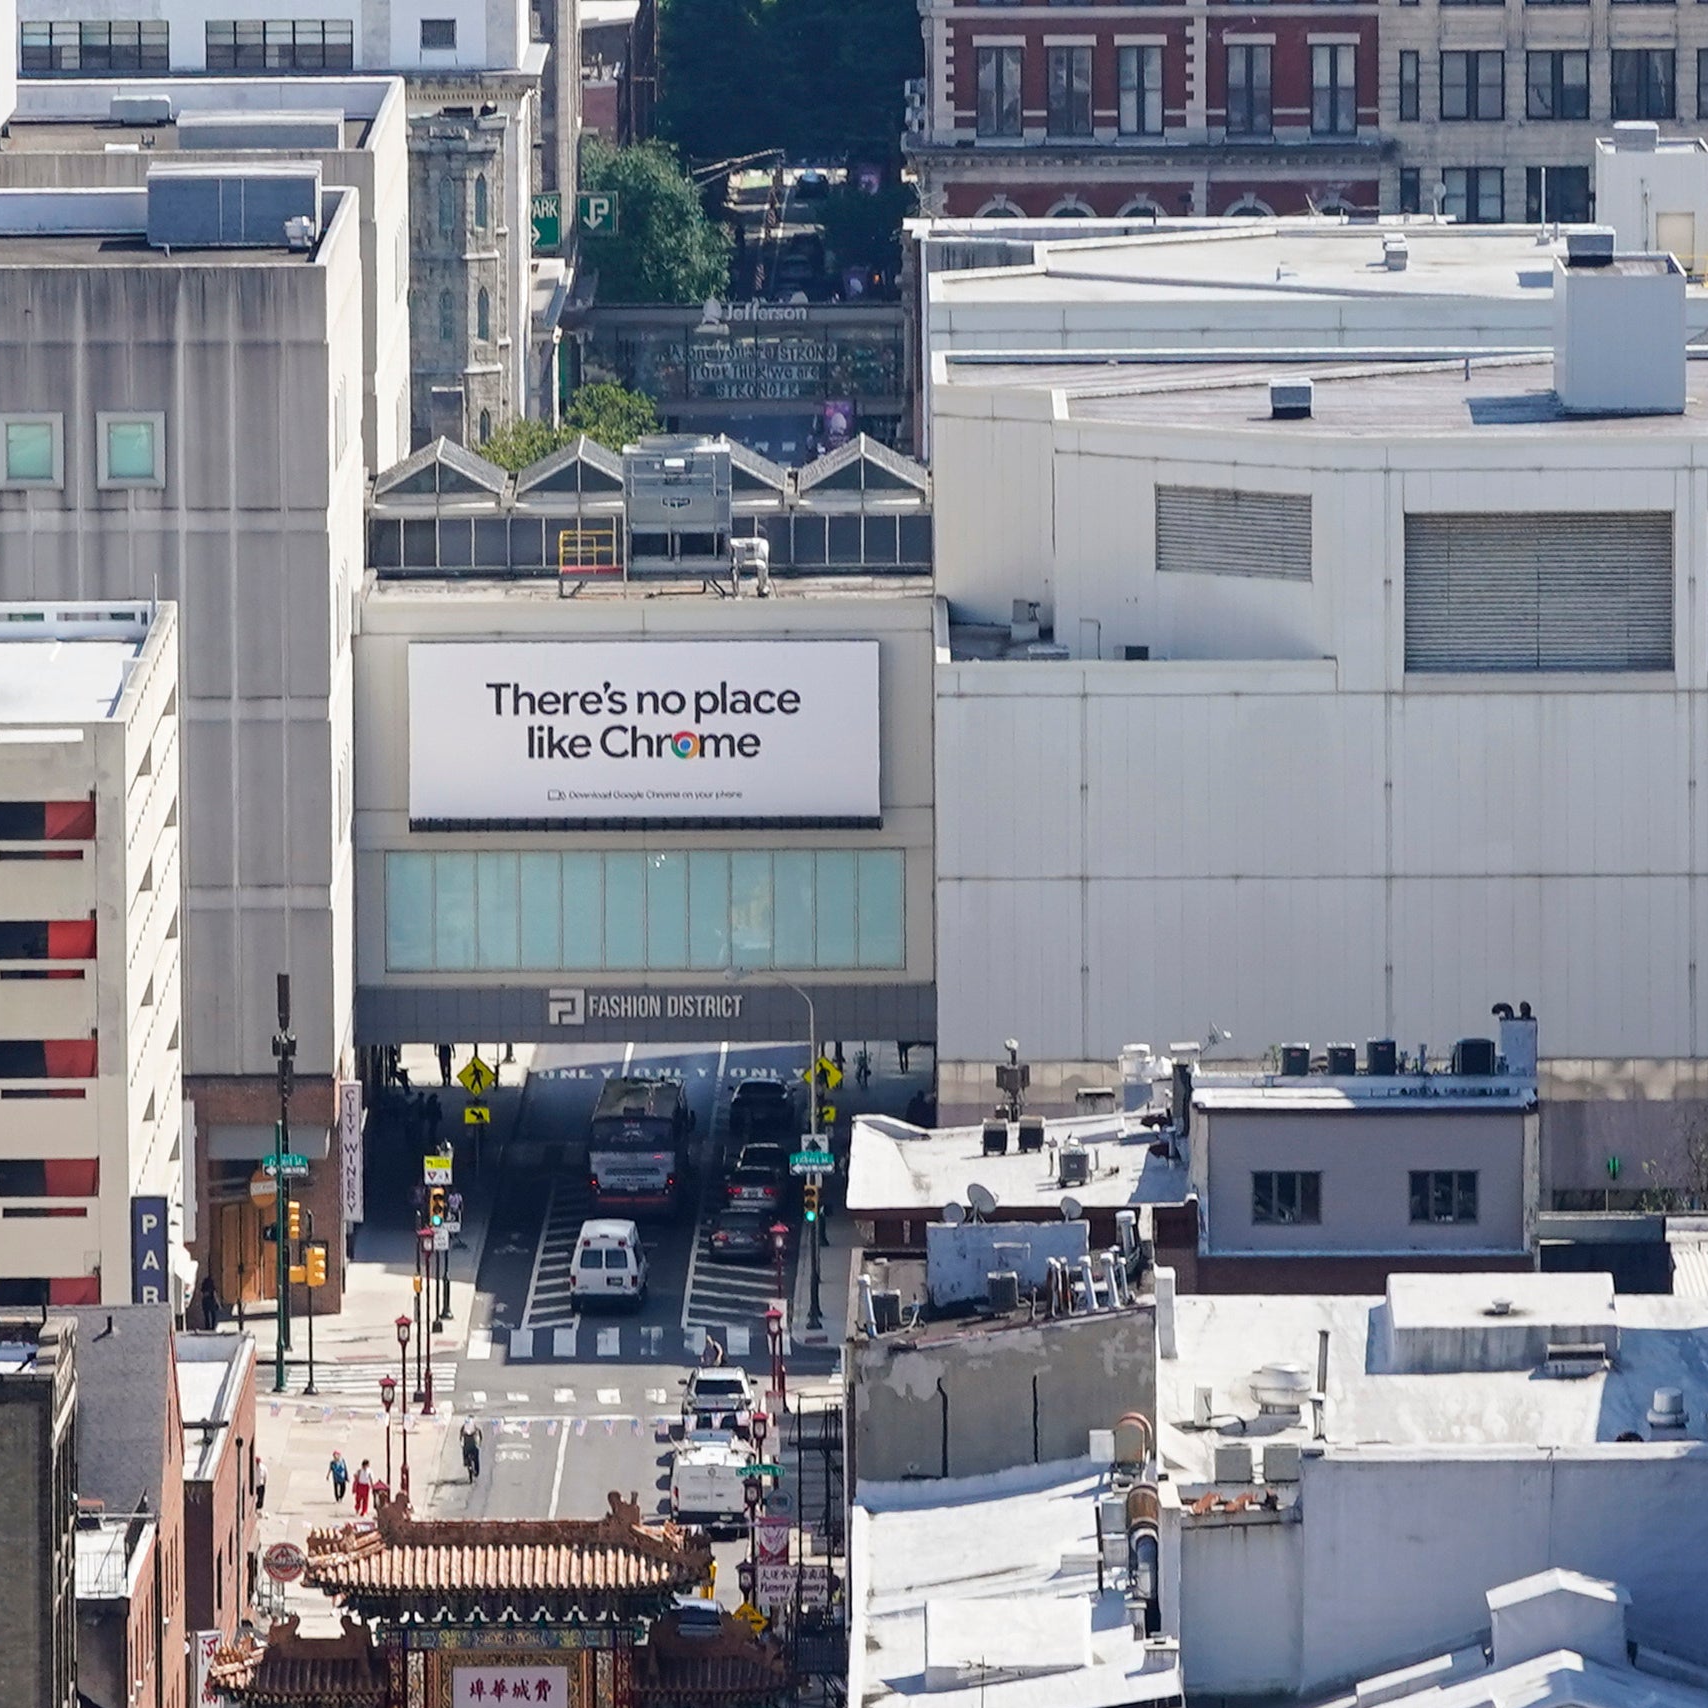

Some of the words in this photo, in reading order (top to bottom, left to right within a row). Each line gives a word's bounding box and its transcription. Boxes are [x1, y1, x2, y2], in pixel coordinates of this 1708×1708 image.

[723, 302, 809, 322] Jefferson
[486, 681, 627, 716] There's
[637, 689, 685, 716] no
[694, 681, 801, 724] place
[527, 726, 591, 760] like
[600, 726, 761, 761] Chrome
[588, 994, 662, 1021] FASHION
[667, 994, 744, 1021] DISTRICT
[344, 1090, 356, 1135] CITY
[344, 1142, 358, 1215] WINERY
